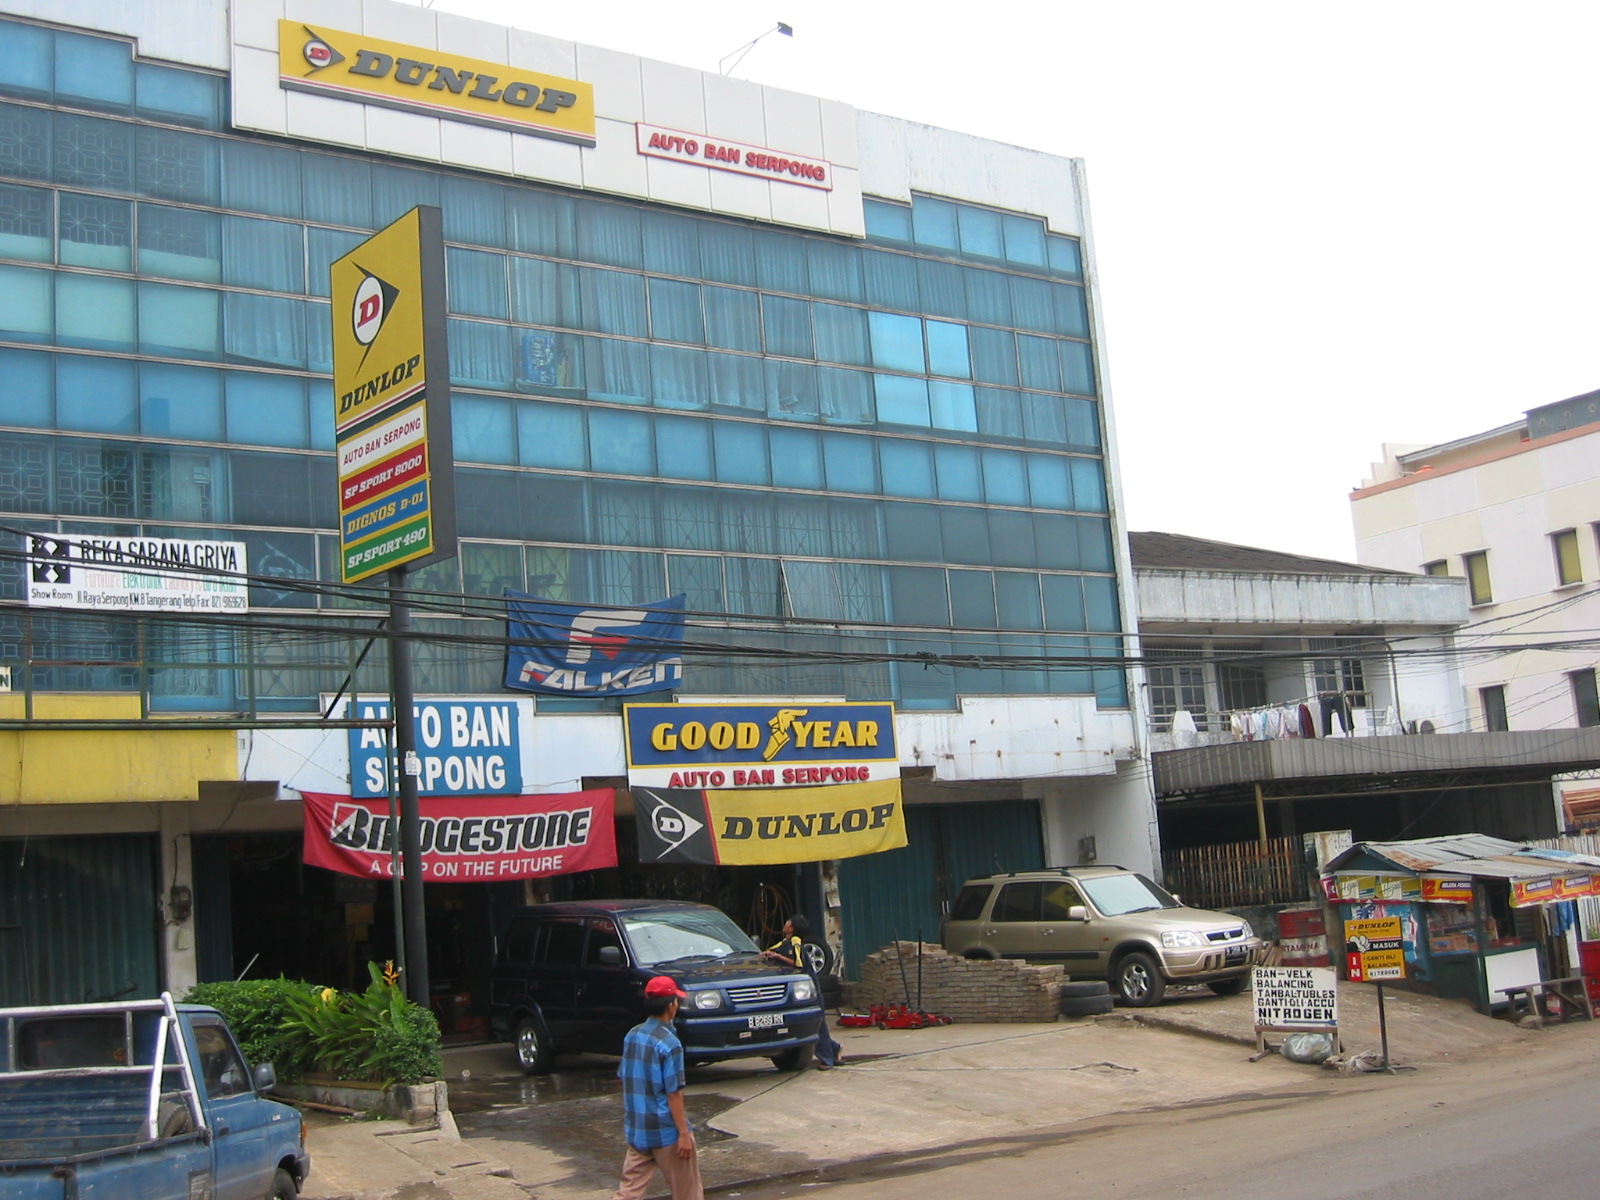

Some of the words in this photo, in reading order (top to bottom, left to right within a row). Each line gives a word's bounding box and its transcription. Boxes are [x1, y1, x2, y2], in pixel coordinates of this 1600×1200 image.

[349, 49, 577, 114] DUNLOP
[648, 133, 698, 155] AUTO
[704, 143, 740, 164] BAN
[745, 152, 826, 182] SERPONG
[339, 354, 420, 414] DUNLOP
[343, 446, 364, 467] AUTO
[365, 438, 382, 456] BAN
[383, 417, 422, 446] SERPONG
[344, 482, 358, 500] SP
[359, 469, 394, 494] SPORT
[394, 454, 423, 477] 8000
[128, 541, 191, 569] SARANA
[194, 544, 238, 571] GRIYA
[347, 553, 363, 570] SP
[363, 537, 402, 563] SPORT
[402, 526, 427, 546] 490
[31, 588, 51, 599] Show
[52, 588, 73, 600] Room
[101, 592, 129, 607] Serpong
[518, 656, 682, 692] FALKEN
[360, 706, 441, 749] AUO
[450, 706, 511, 748] BAN
[651, 721, 761, 751] GOOD
[791, 720, 879, 749] YEAR
[668, 770, 726, 789] AUTO
[733, 769, 775, 786] BAN
[782, 766, 870, 785] SERPONG
[330, 803, 593, 856] BRDGESTONE
[721, 803, 895, 840] DUNLOP
[370, 860, 382, 875] A
[433, 861, 458, 877] ON
[464, 859, 495, 877] THE
[500, 854, 564, 875] FUTURE
[1358, 921, 1395, 930] DUNLOP
[1372, 941, 1400, 949] MASUK
[1367, 961, 1401, 969] BALANCING
[1370, 969, 1399, 977] NITROGEN
[1256, 979, 1314, 989] BALANCING
[1258, 1007, 1333, 1020] NITROGEN
